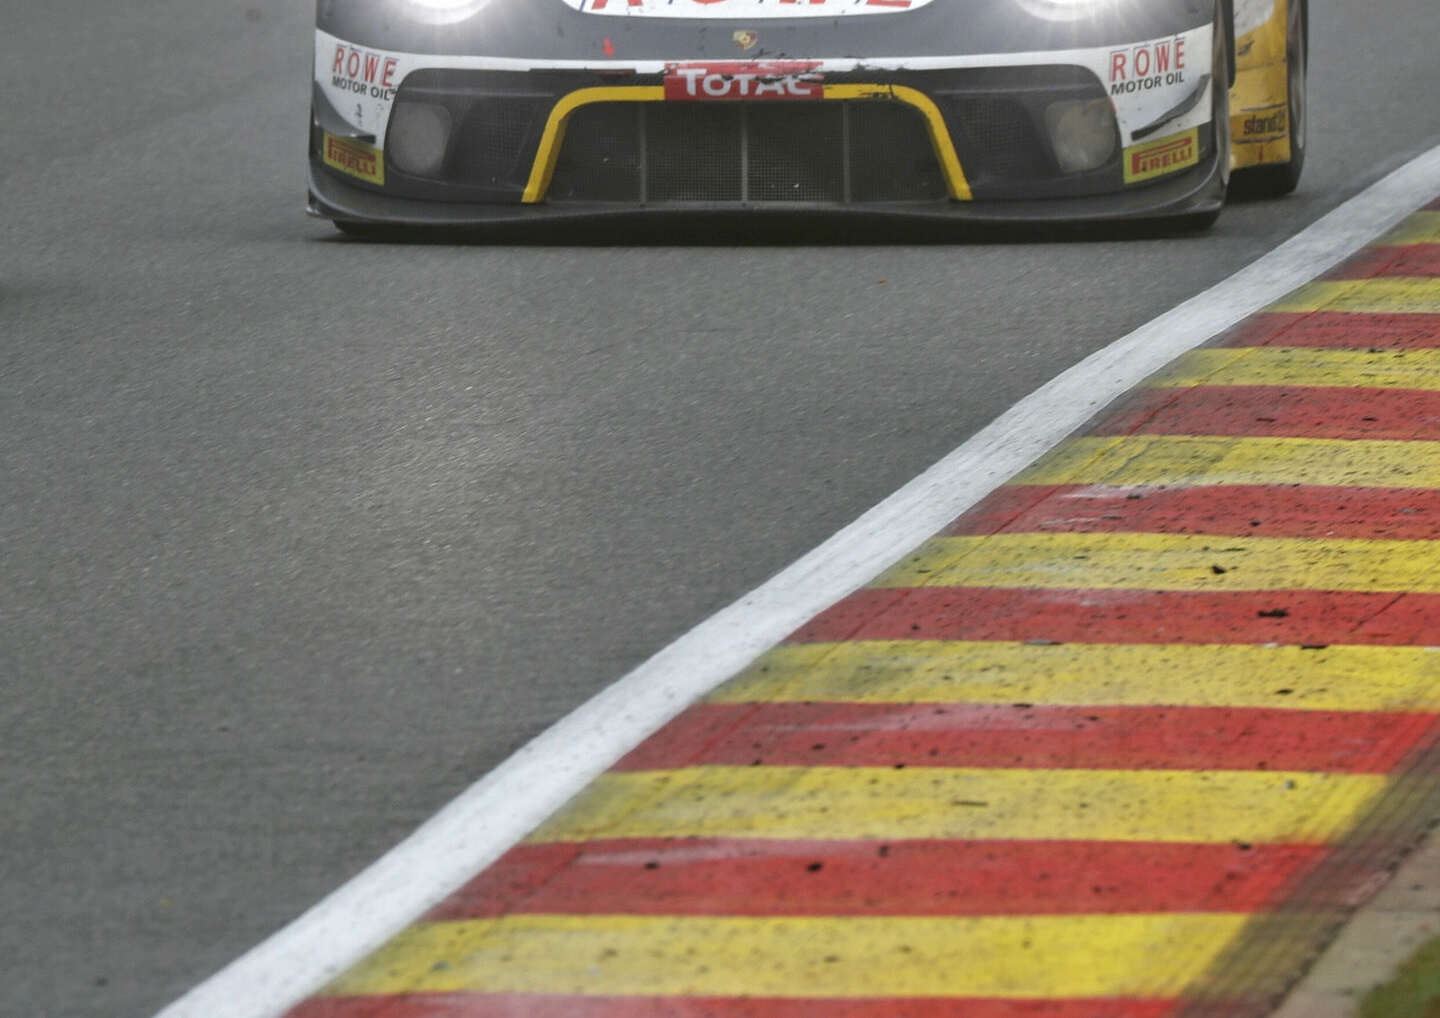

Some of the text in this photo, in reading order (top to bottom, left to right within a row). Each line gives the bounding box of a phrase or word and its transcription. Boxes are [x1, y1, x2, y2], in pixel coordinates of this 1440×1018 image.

[332, 46, 398, 88] ROWE
[1111, 40, 1186, 82] ROWE
[331, 75, 368, 95] MOTOR
[1111, 70, 1185, 96] MOTOR OIL
[327, 136, 377, 176] PIRELLI
[1131, 136, 1193, 175] PIRELLI
